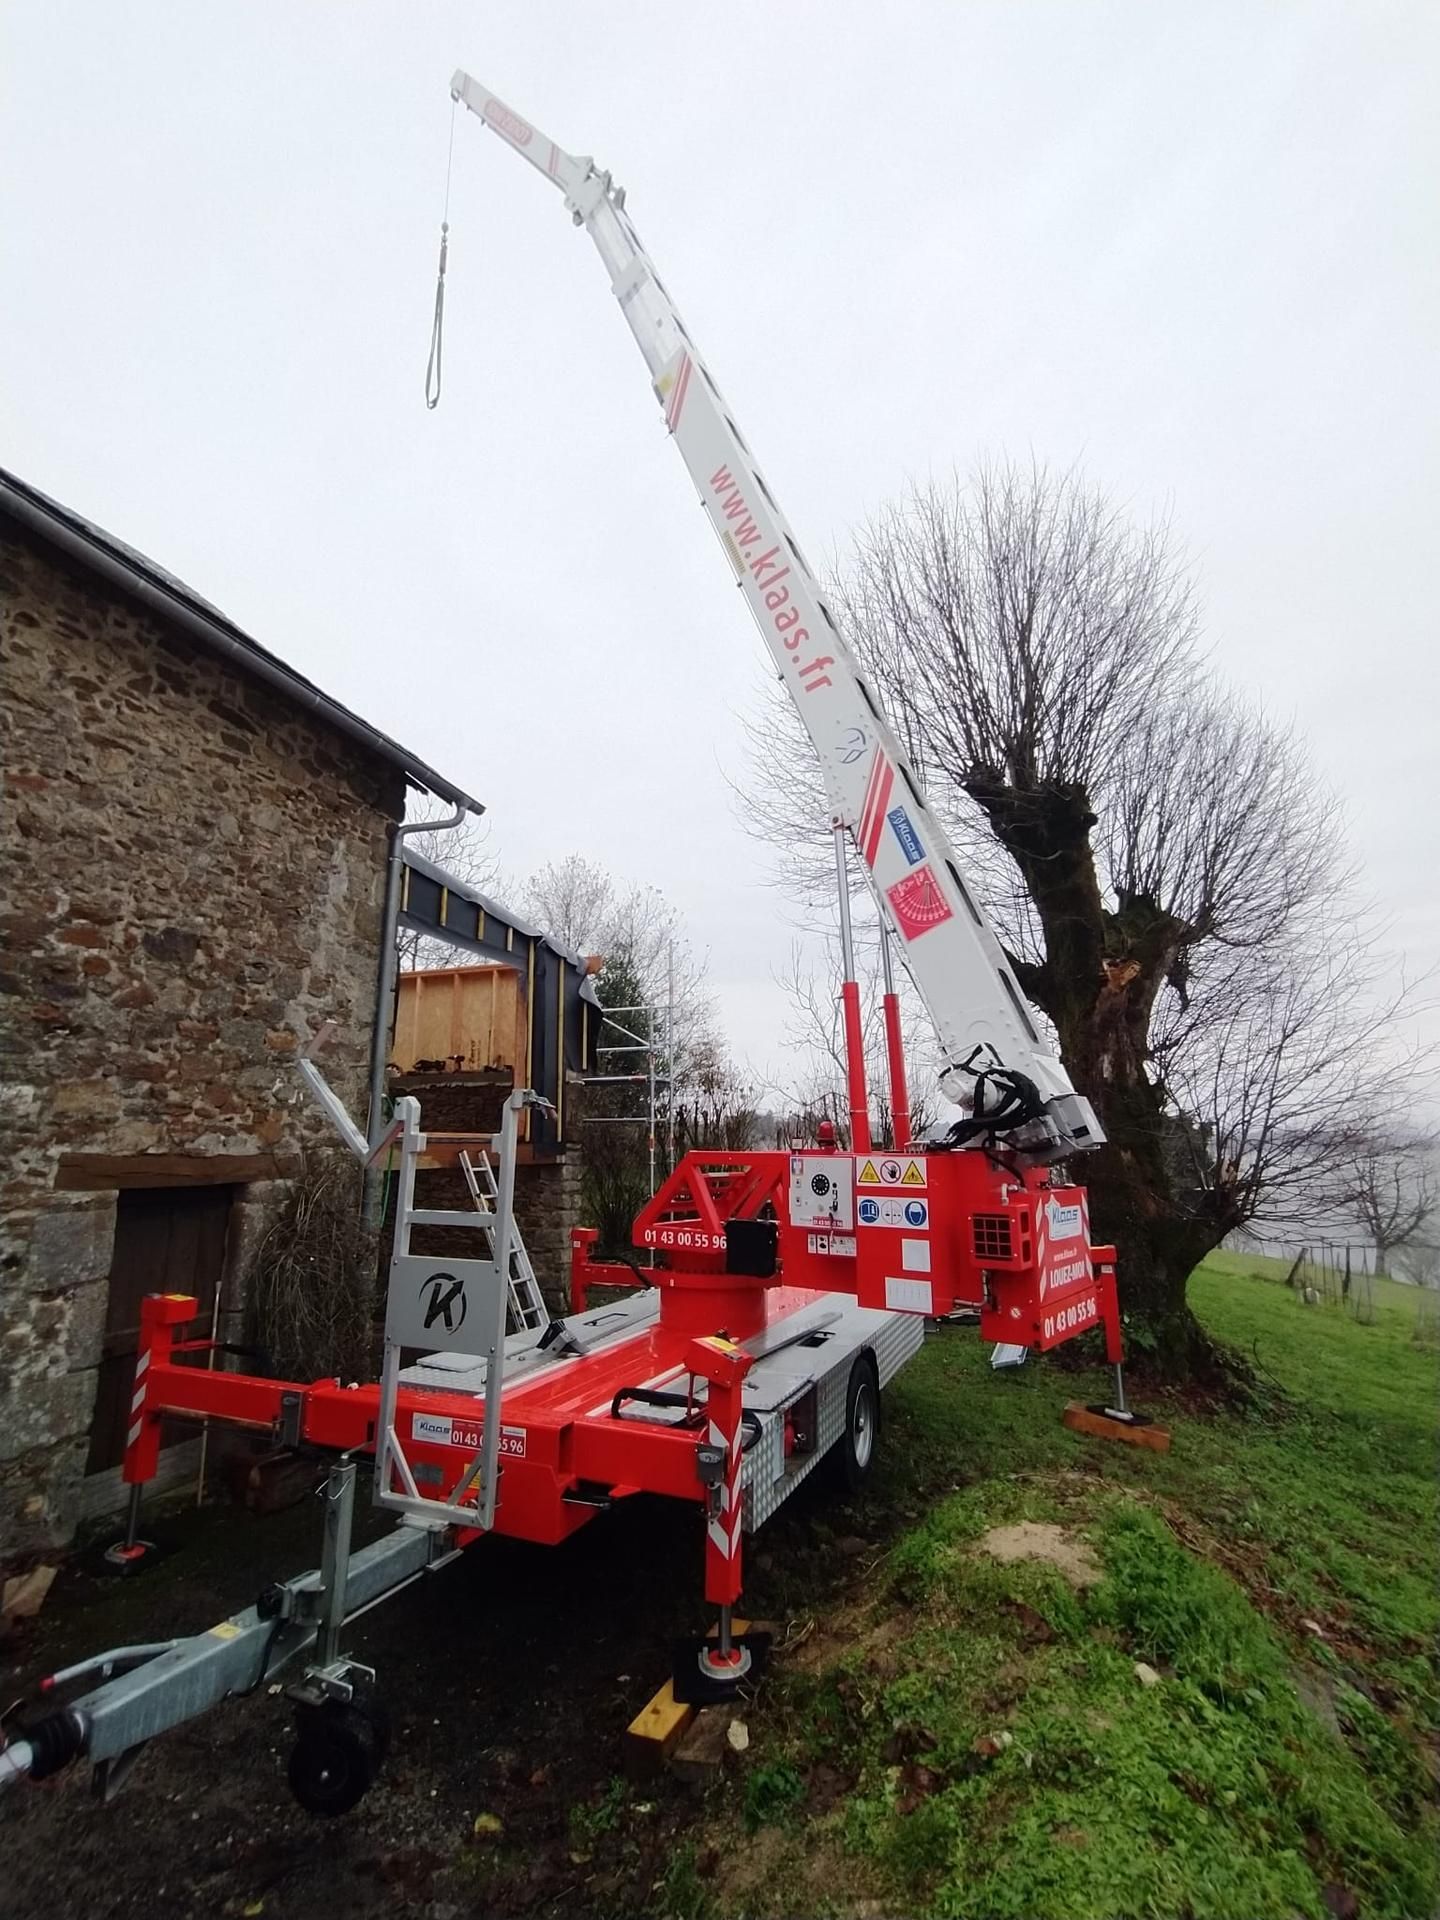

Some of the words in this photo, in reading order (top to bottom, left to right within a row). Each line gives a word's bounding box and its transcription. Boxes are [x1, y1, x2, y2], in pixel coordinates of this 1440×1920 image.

[710, 464, 835, 693] www.klaas.fr
[644, 1229, 656, 1243] 01
[661, 1231, 674, 1244] 43
[677, 1232, 691, 1246] 00
[695, 1234, 709, 1248] 55
[712, 1235, 727, 1249] 96
[1044, 1316, 1054, 1339] 01
[1056, 1311, 1067, 1332] 43
[1067, 1306, 1077, 1327] 00
[1077, 1301, 1087, 1322] 55
[1087, 1297, 1096, 1317] 96
[452, 1430, 463, 1443] 01
[464, 1432, 478, 1446] 43
[510, 1440, 523, 1453] 96
